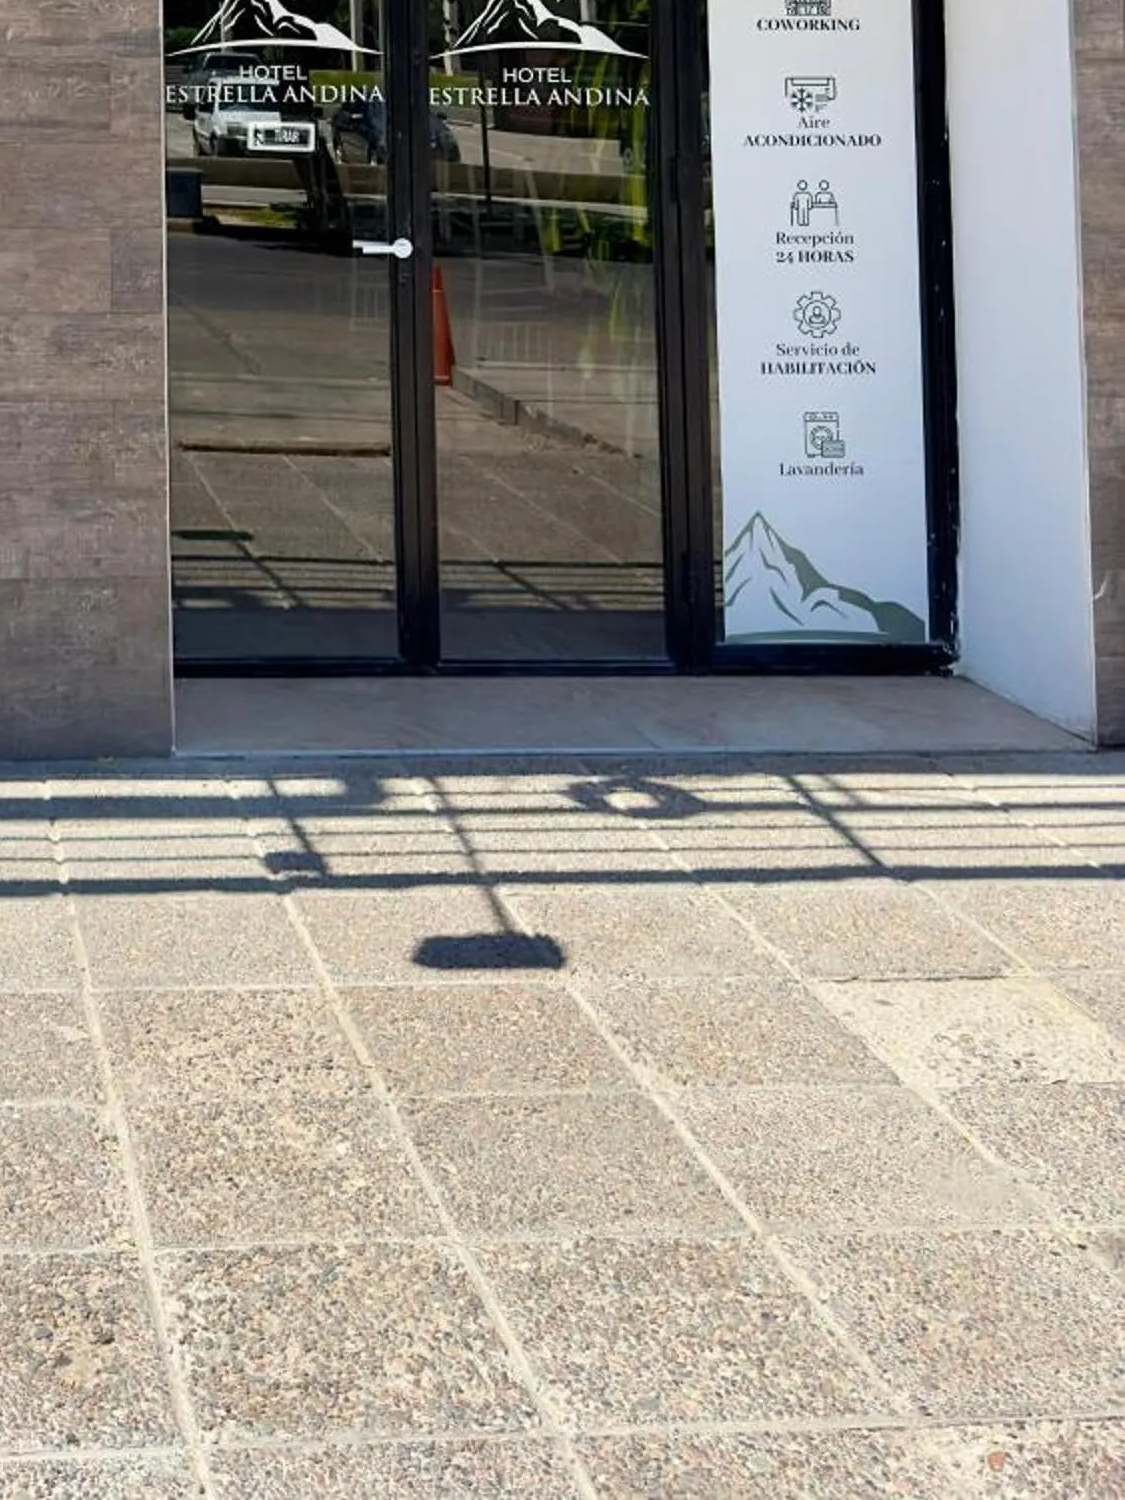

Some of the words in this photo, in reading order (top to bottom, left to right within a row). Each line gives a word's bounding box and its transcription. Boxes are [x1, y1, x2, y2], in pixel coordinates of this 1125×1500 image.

[756, 18, 860, 32] COWORKING
[239, 65, 308, 81] HOTEL
[502, 67, 572, 83] HOTEL
[165, 84, 277, 103] ESTRELLA
[282, 83, 385, 103] ANDINA
[429, 86, 542, 106] ESTRELLA
[547, 86, 651, 106] ANDINA
[798, 115, 831, 129] Aire
[744, 134, 882, 148] ACONDICIONADO
[776, 231, 855, 249] Recepción
[776, 251, 794, 265] 24
[798, 250, 855, 264] HORAS
[776, 343, 838, 357] Servicio
[841, 342, 860, 357] de
[761, 360, 876, 376] HABILITACIÓN
[779, 461, 864, 477] Lavandería
